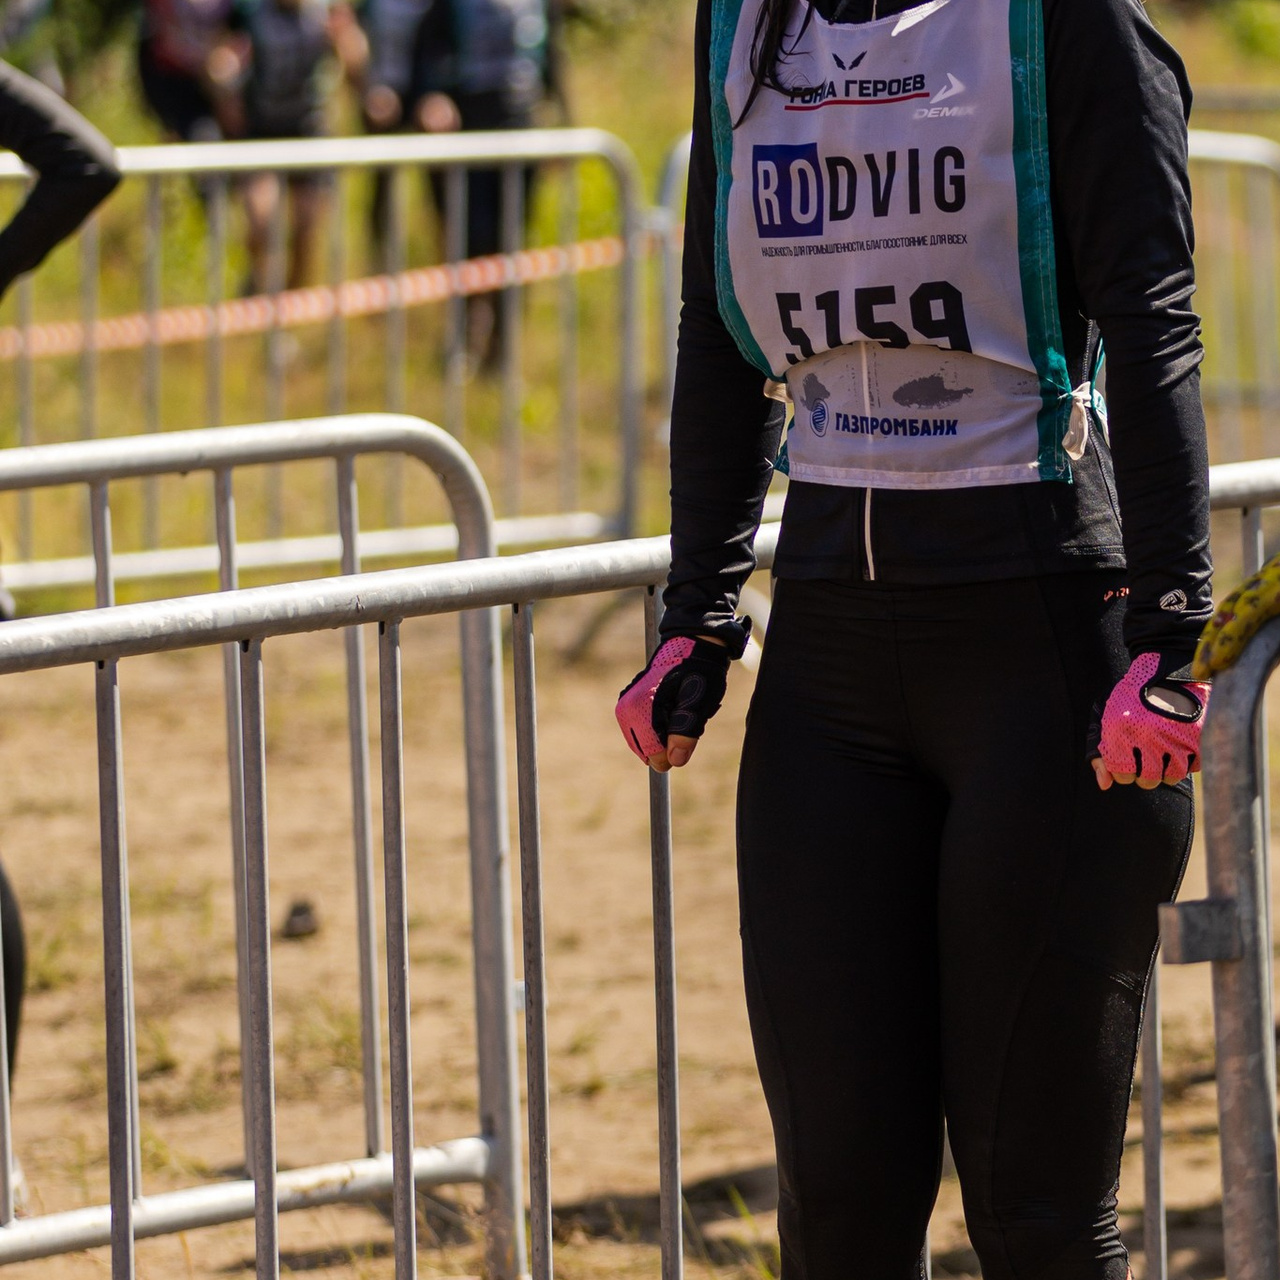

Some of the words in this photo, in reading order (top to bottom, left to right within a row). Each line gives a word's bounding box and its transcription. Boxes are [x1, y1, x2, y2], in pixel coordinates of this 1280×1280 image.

[844, 74, 925, 98] ГЕРОЕВ
[912, 105, 977, 120] DEMIX
[758, 145, 967, 226] RODVIG
[866, 235, 928, 251] БЛАГОСОСТОЯНИЕ
[929, 234, 946, 247] ДЛЯ
[947, 234, 967, 245] ВСЕХ
[775, 280, 973, 365] 5159
[835, 412, 959, 437] ГАЗПРОМБАНК
